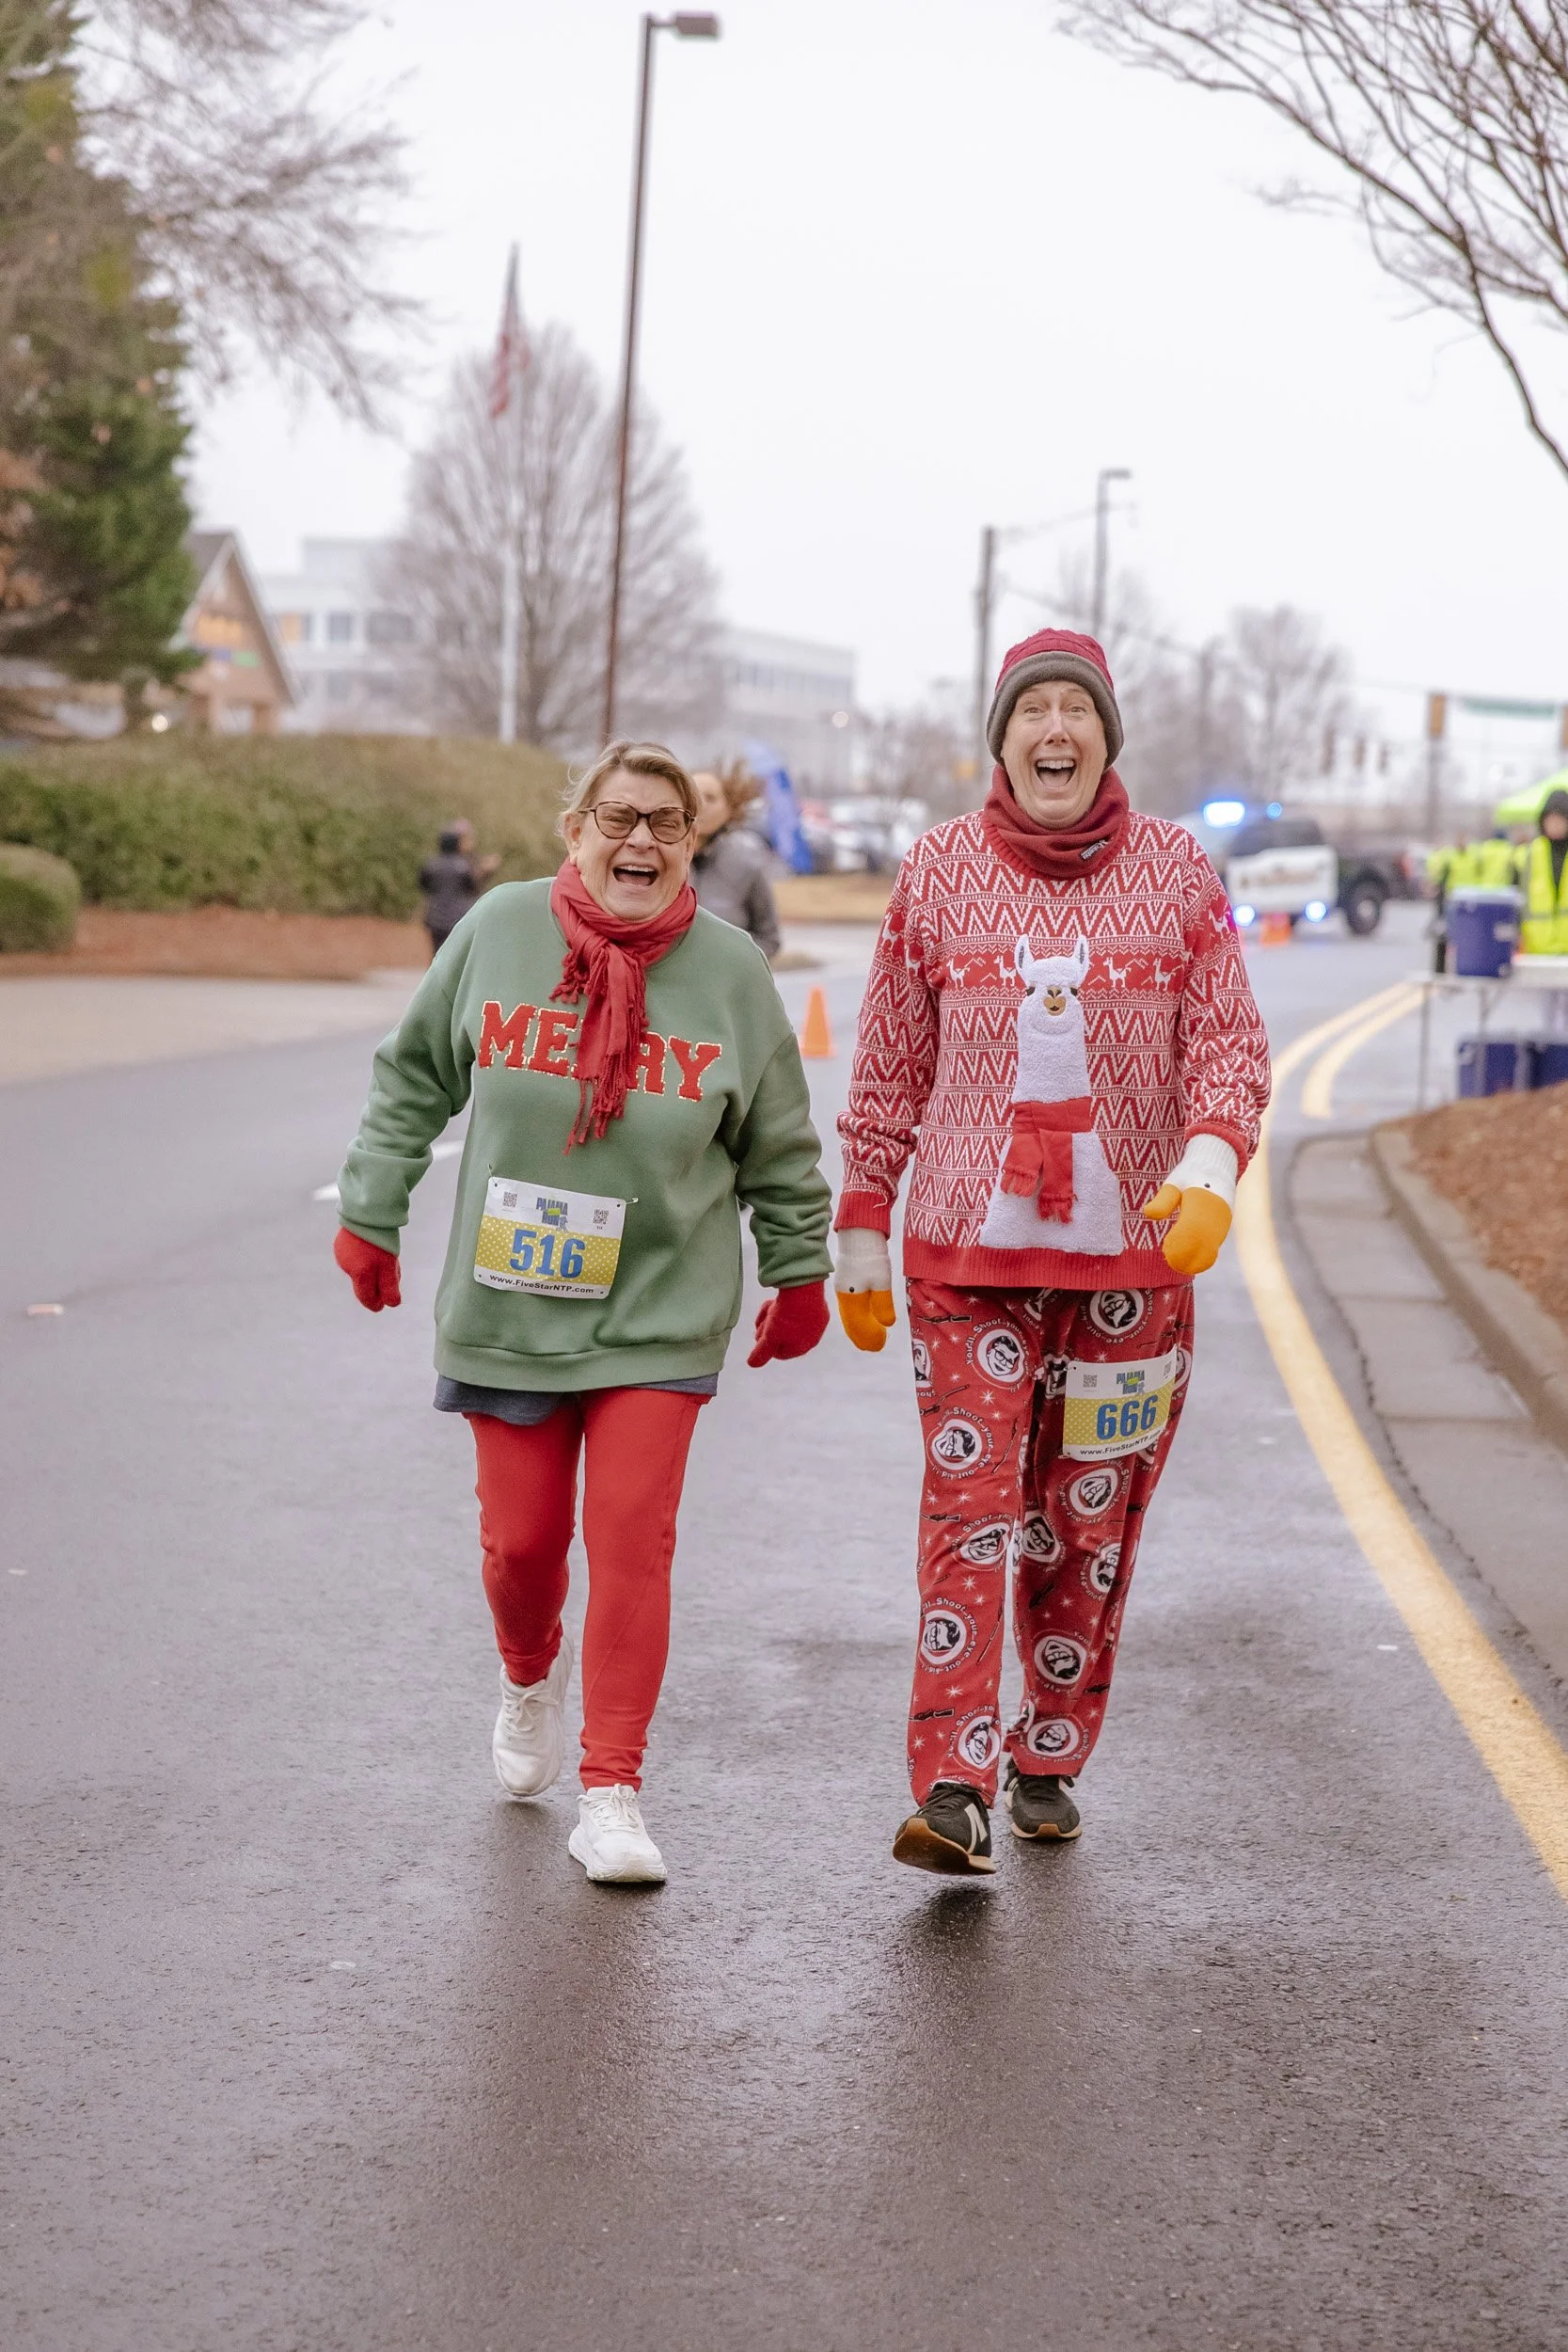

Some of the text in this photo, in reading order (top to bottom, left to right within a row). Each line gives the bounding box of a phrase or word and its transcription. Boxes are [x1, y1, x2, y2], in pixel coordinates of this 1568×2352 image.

[480, 1001, 721, 1102] MERY
[510, 1229, 585, 1279] 516
[490, 1274, 594, 1294] www.FiveStarNTP.com
[1097, 1395, 1158, 1440] 666
